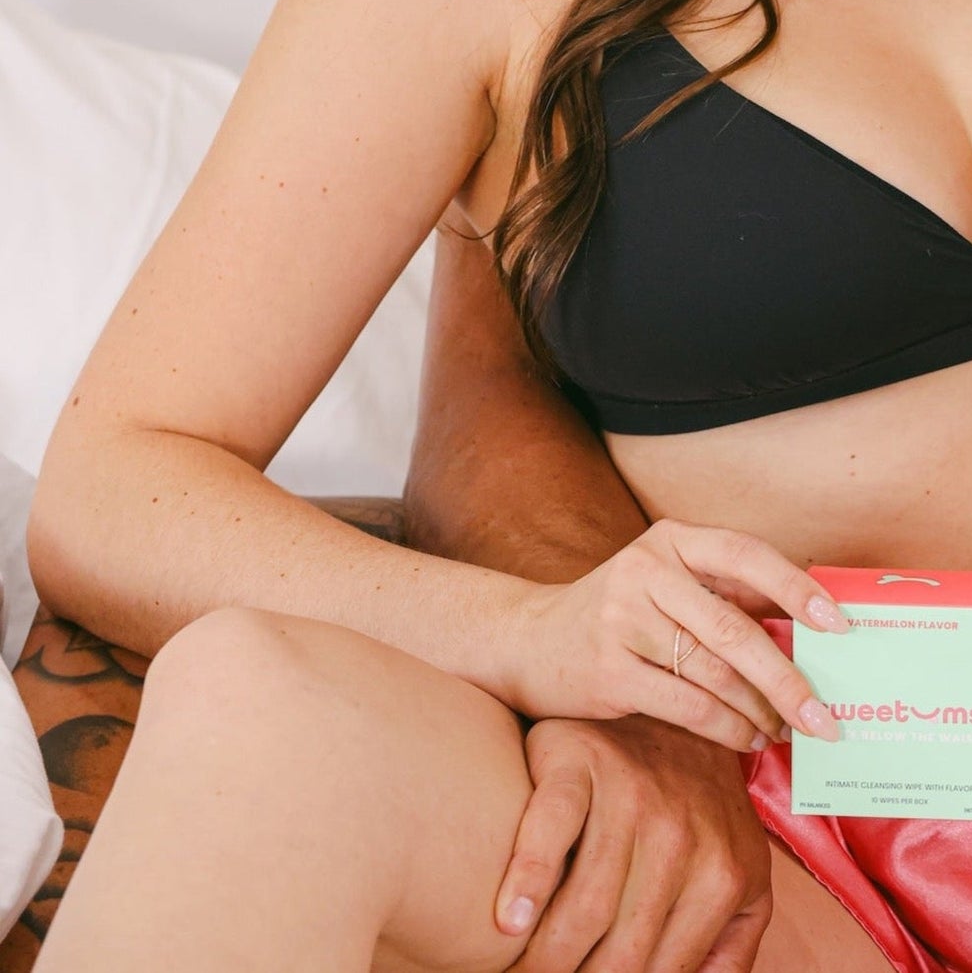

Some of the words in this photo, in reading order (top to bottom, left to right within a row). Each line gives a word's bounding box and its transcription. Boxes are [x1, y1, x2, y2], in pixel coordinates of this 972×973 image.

[917, 620, 959, 631] FLAVOR
[861, 730, 906, 742] BELOW
[910, 731, 935, 742] THE
[825, 780, 859, 789] INTIMATE
[860, 781, 903, 790] CLEANSING
[904, 782, 924, 791] WIPE
[924, 783, 944, 791] WITH
